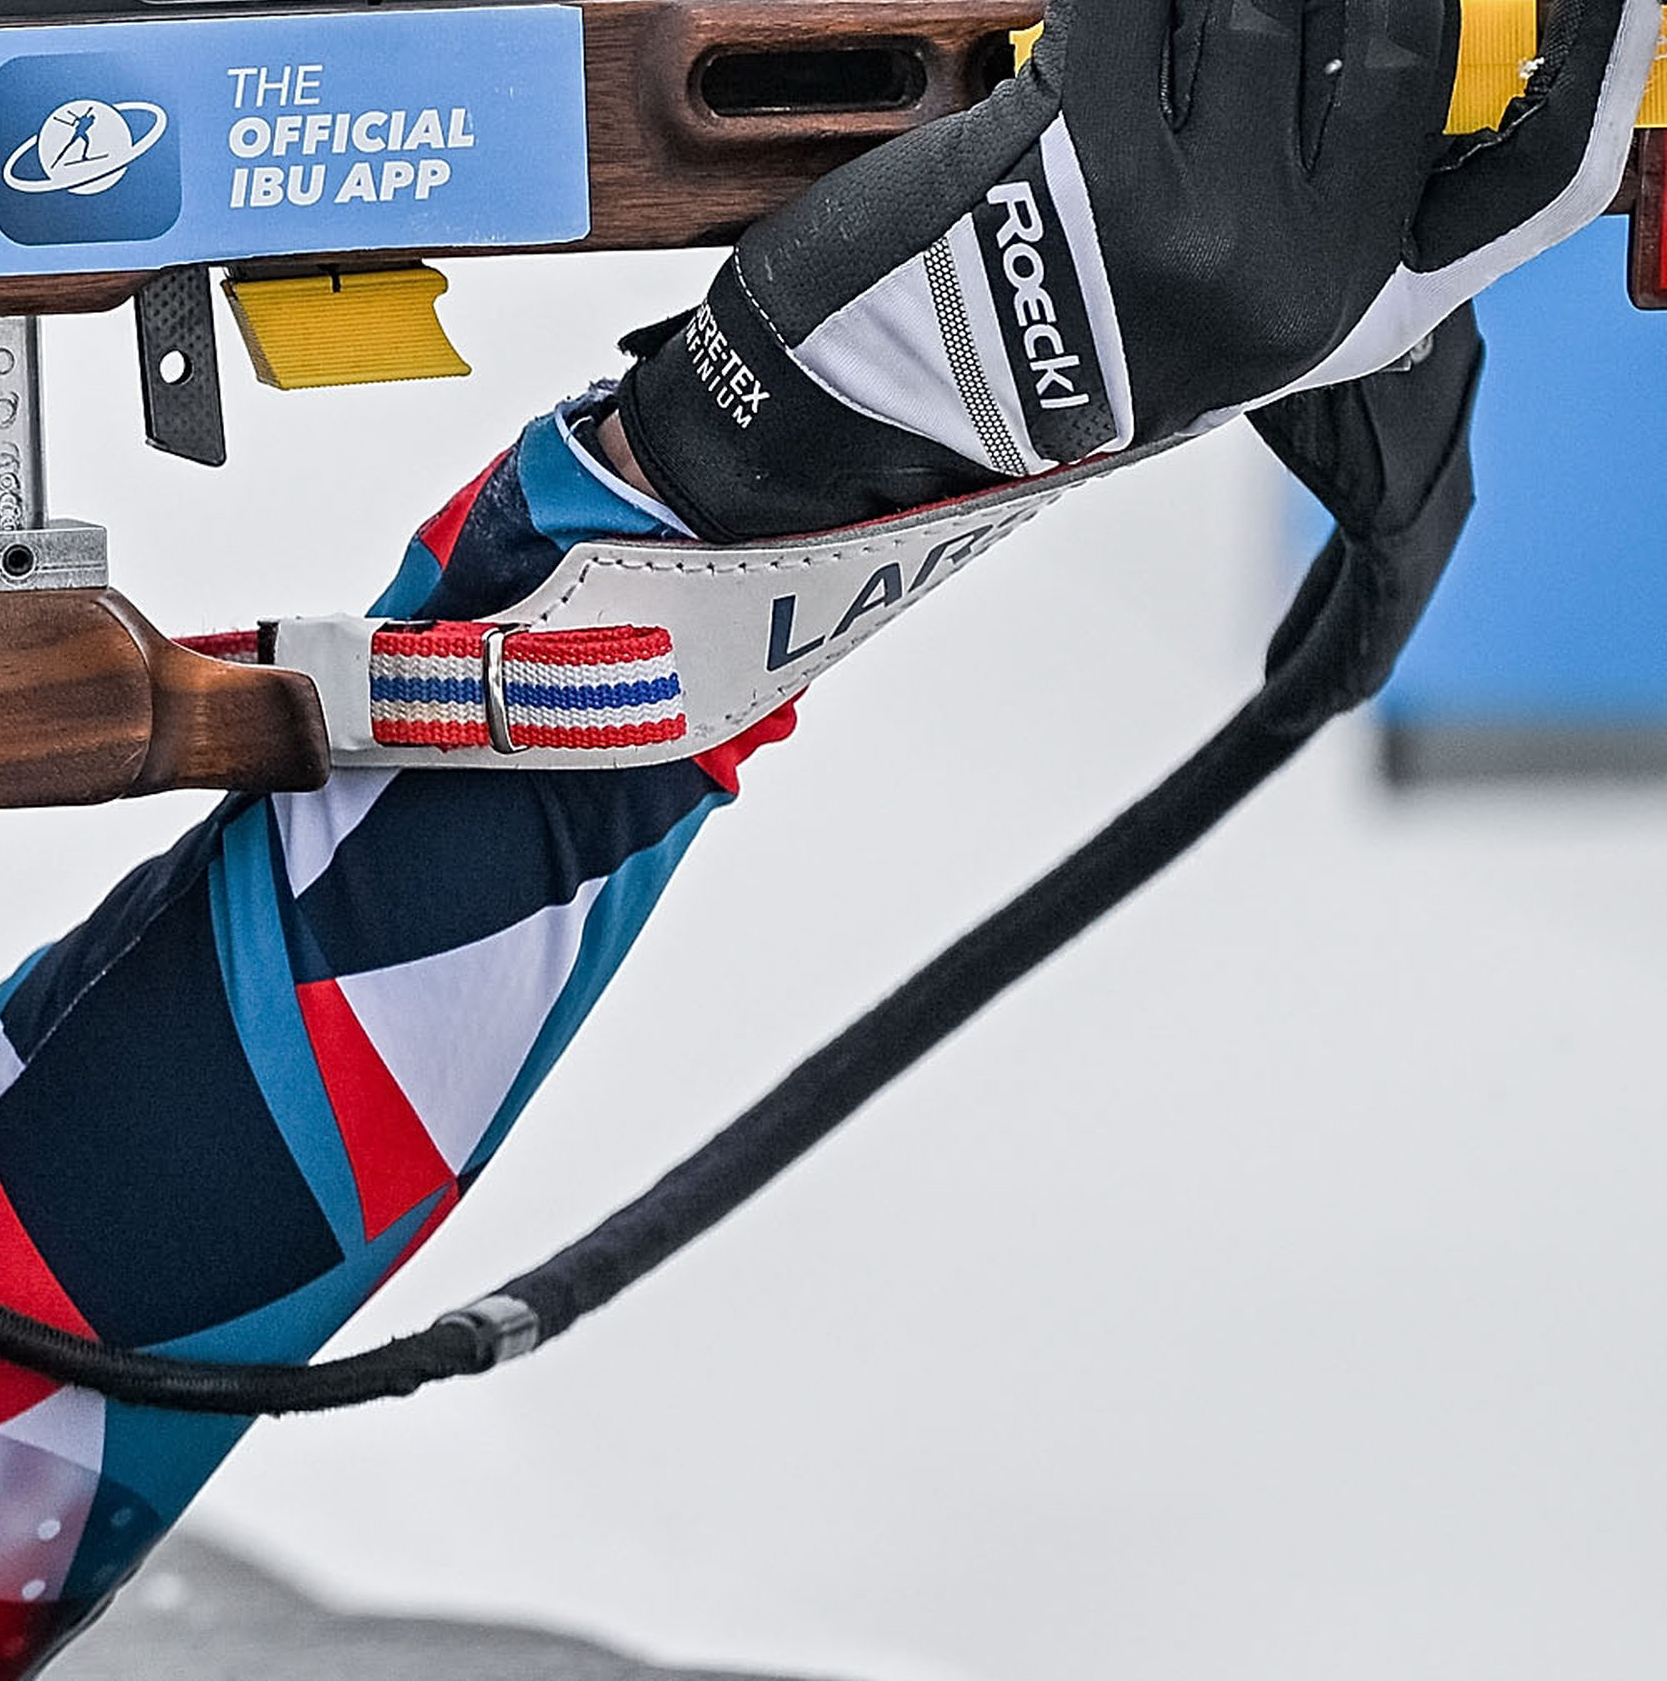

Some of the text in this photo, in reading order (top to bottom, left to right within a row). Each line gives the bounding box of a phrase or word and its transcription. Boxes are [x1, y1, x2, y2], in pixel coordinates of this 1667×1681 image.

[227, 65, 323, 108] THE
[229, 108, 474, 158] OFFICIAL
[230, 159, 451, 208] IBU APP
[697, 300, 770, 414] ORE-TEX
